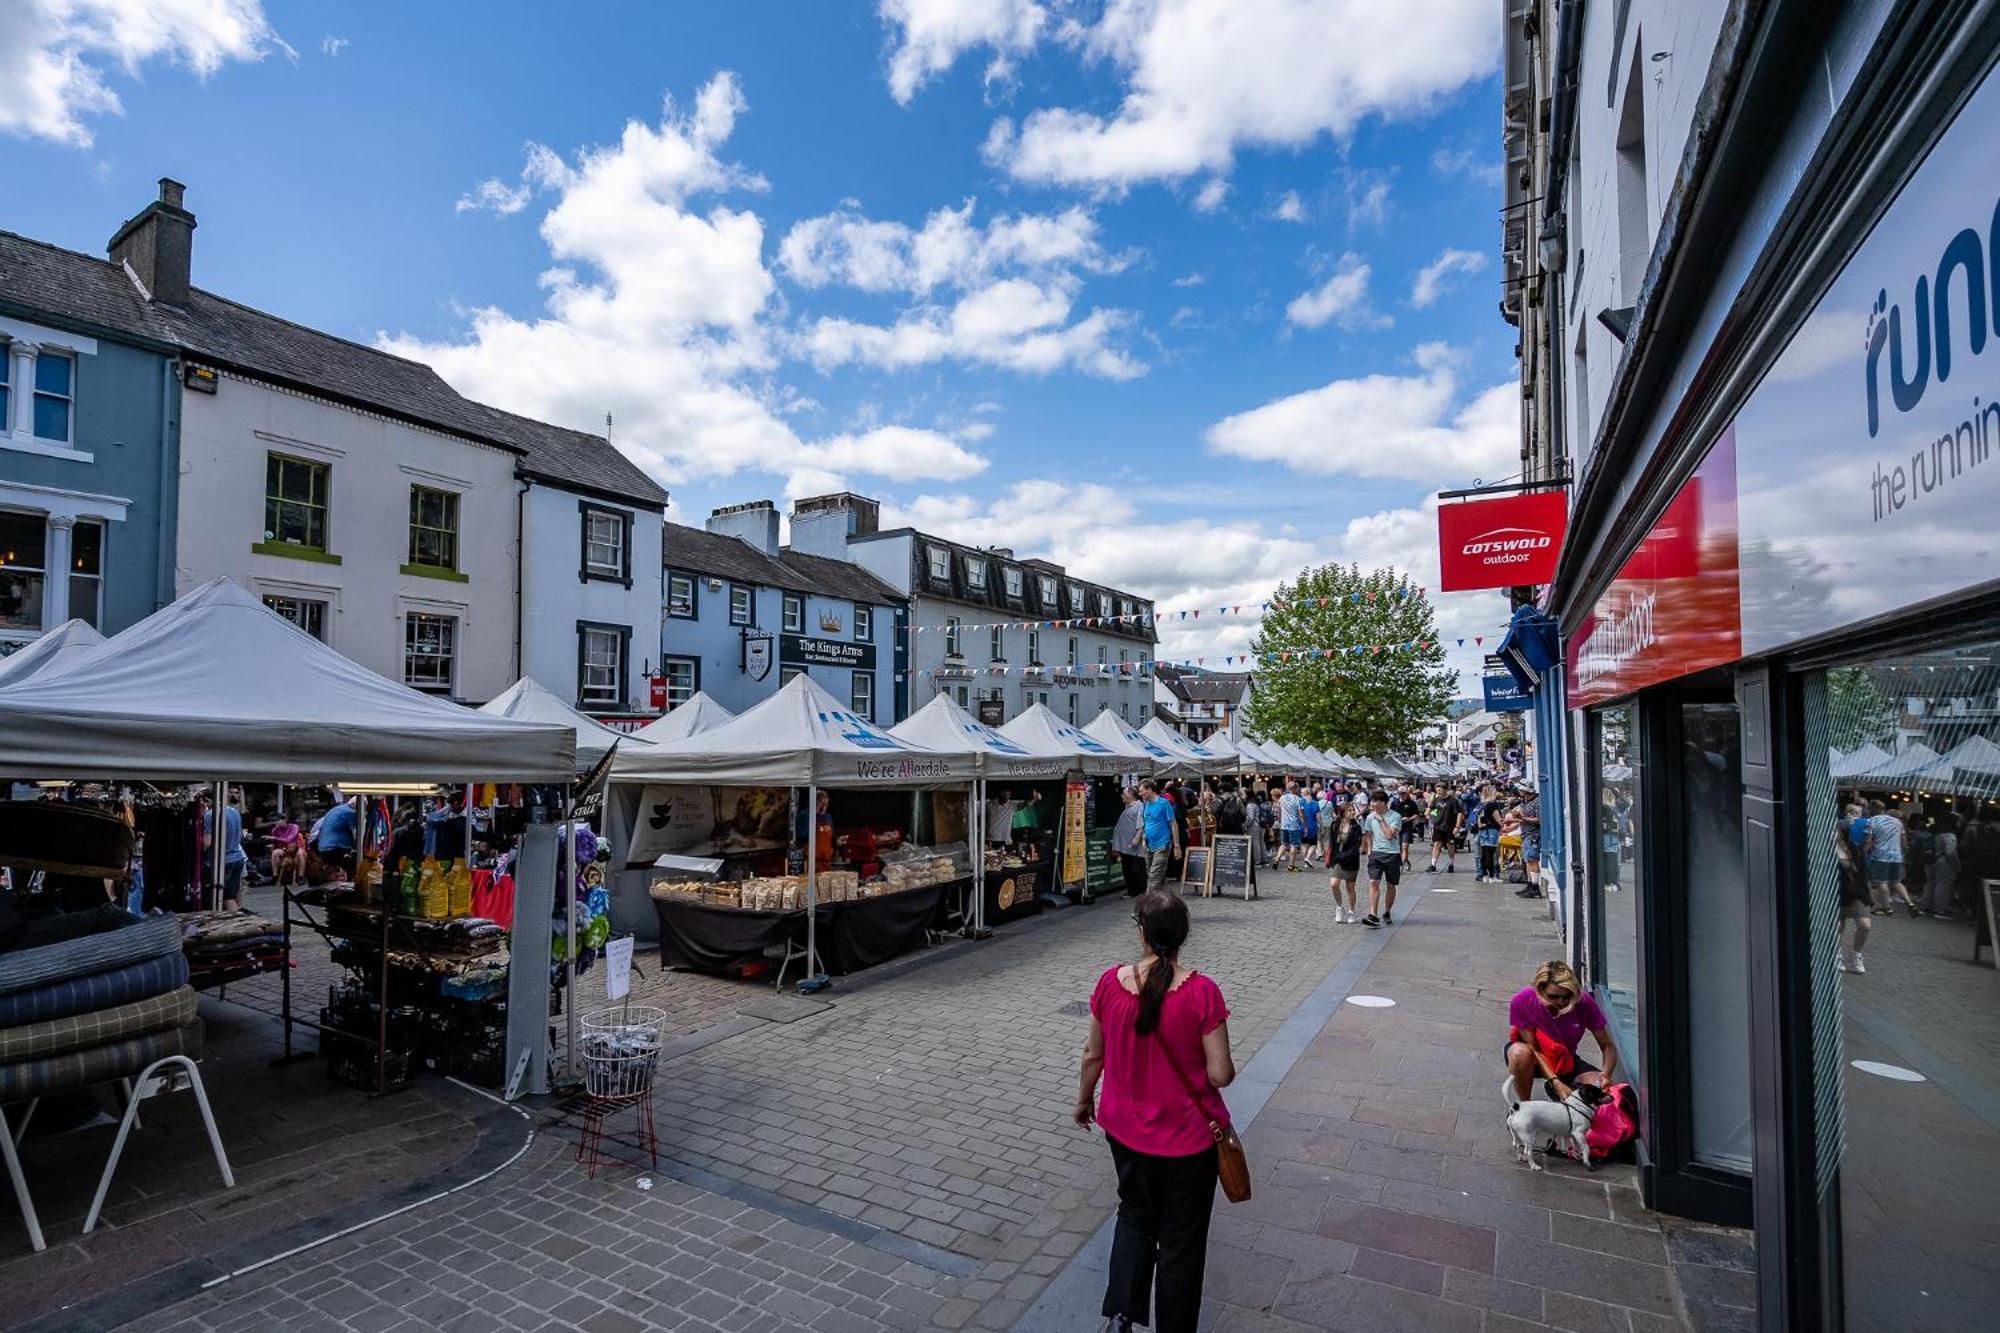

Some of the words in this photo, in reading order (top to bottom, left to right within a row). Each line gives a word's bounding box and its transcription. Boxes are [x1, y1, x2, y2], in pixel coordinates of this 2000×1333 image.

[1871, 461, 1906, 522] the
[1462, 537, 1551, 554] COTSWOLD
[1483, 553, 1530, 565] outdoor
[799, 639, 815, 652] The
[816, 642, 841, 657] Kings
[841, 646, 864, 657] Arms
[857, 760, 897, 778] We're
[898, 759, 950, 778] Allerdale
[584, 792, 602, 805] PET
[573, 803, 597, 818] STALL
